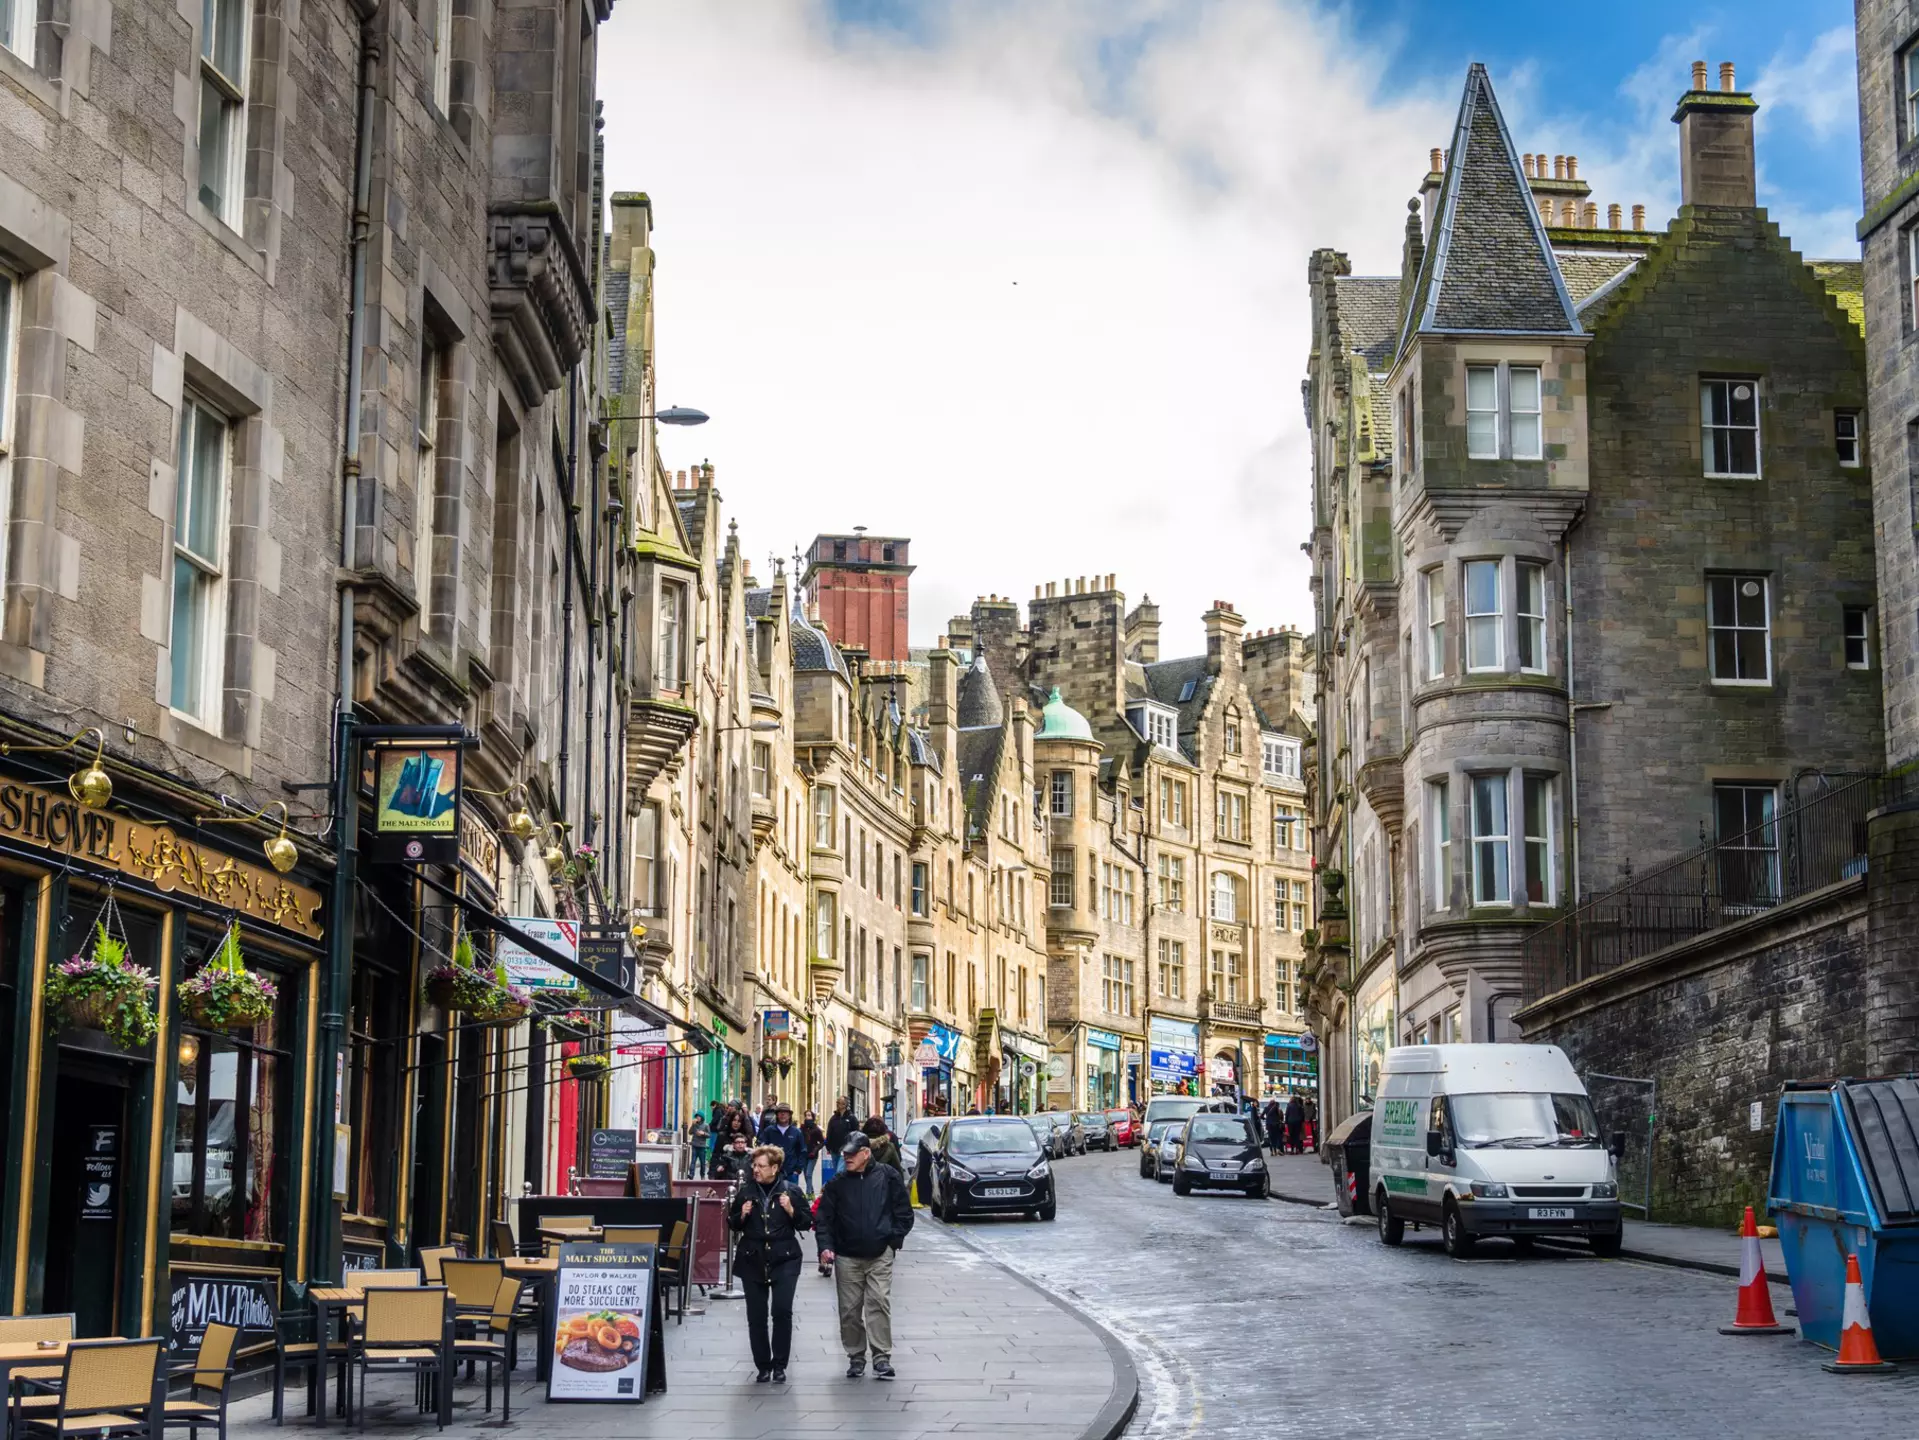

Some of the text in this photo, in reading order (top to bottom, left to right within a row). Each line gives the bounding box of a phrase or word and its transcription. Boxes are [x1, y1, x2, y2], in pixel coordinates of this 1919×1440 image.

[0, 785, 120, 865] SHOVEL
[421, 820, 452, 828] SHOVEL
[528, 928, 546, 939] Fraser
[547, 930, 562, 941] Legal
[597, 945, 617, 953] vino
[1384, 1101, 1419, 1125] BREMAC
[1537, 1209, 1566, 1218] R3 FYN
[565, 1255, 648, 1263] MALT SHOVEL INN
[568, 1284, 637, 1295] DO STEAKS COME
[186, 1283, 246, 1325] MALT
[564, 1295, 640, 1306] MORE SUCCULENT?
